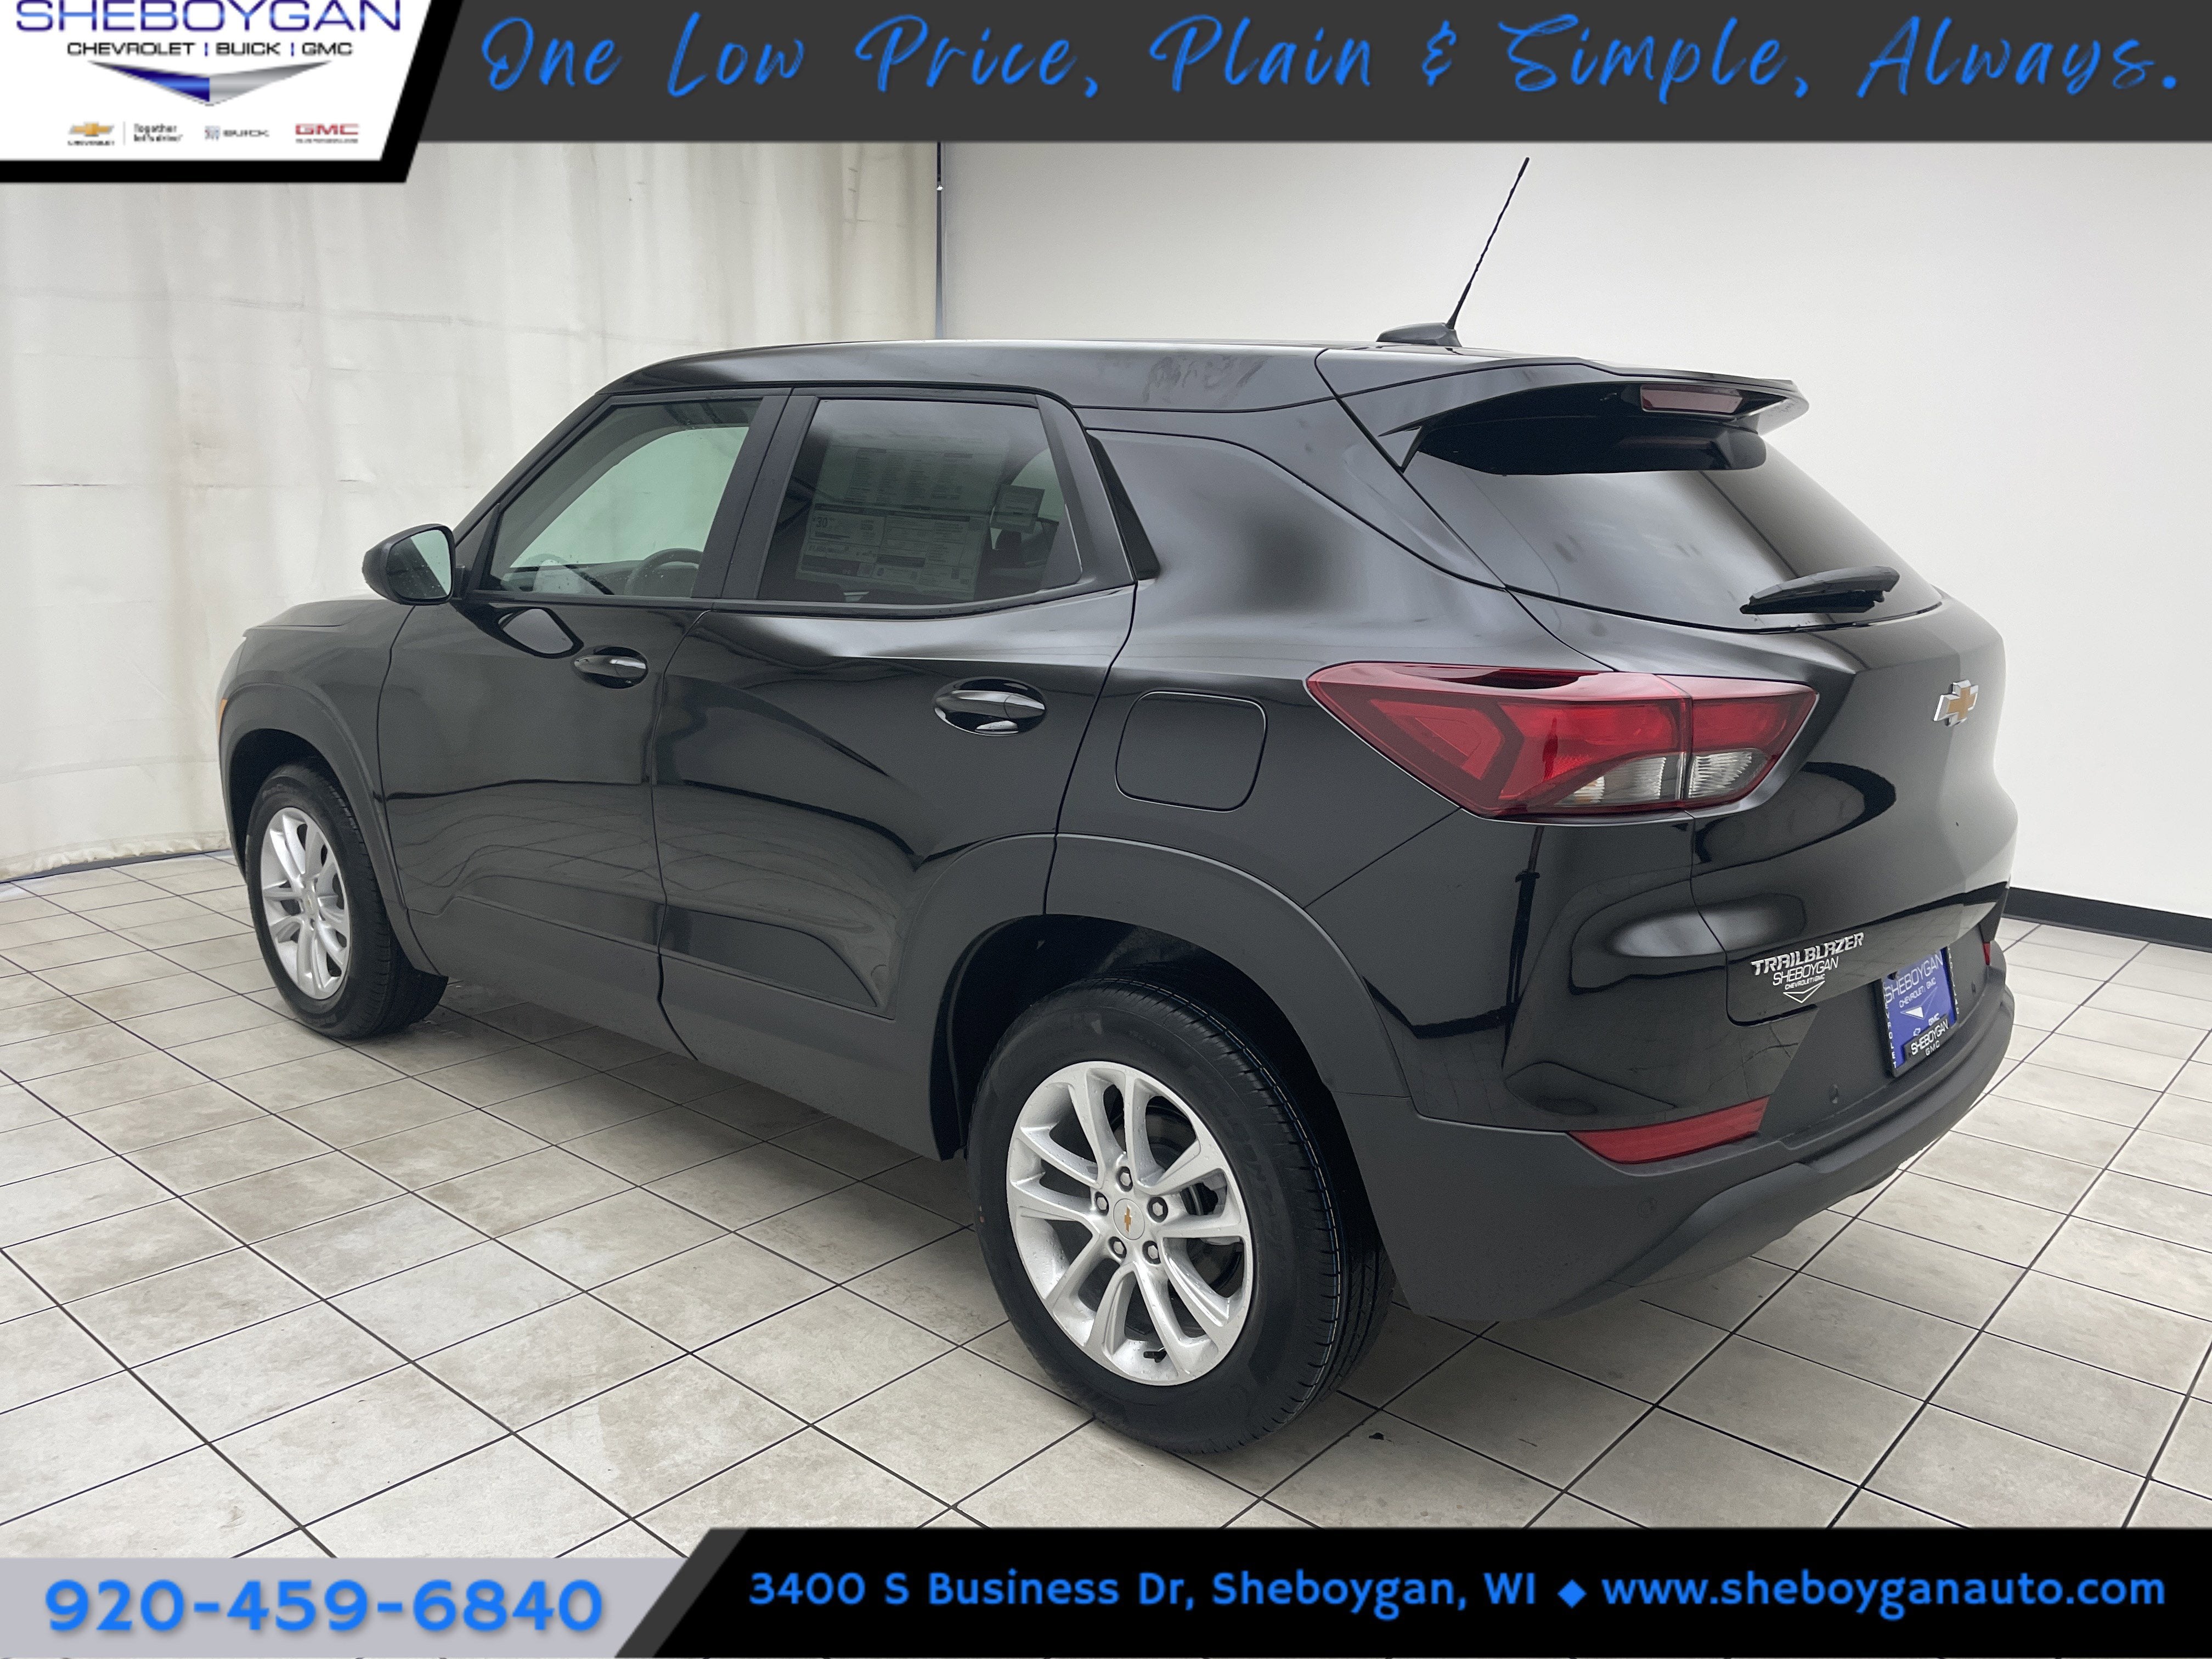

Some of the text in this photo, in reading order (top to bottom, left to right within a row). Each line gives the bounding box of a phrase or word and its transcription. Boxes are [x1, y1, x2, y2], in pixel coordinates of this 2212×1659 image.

[1750, 932, 1865, 976] TRAILBLAZER
[1772, 956, 1839, 986] SHEBOYGAN
[1883, 951, 1944, 1003] SHEBOYGAN
[1911, 1018, 1949, 1056] SHEBOYGAN
[1925, 1040, 1940, 1056] GMC
